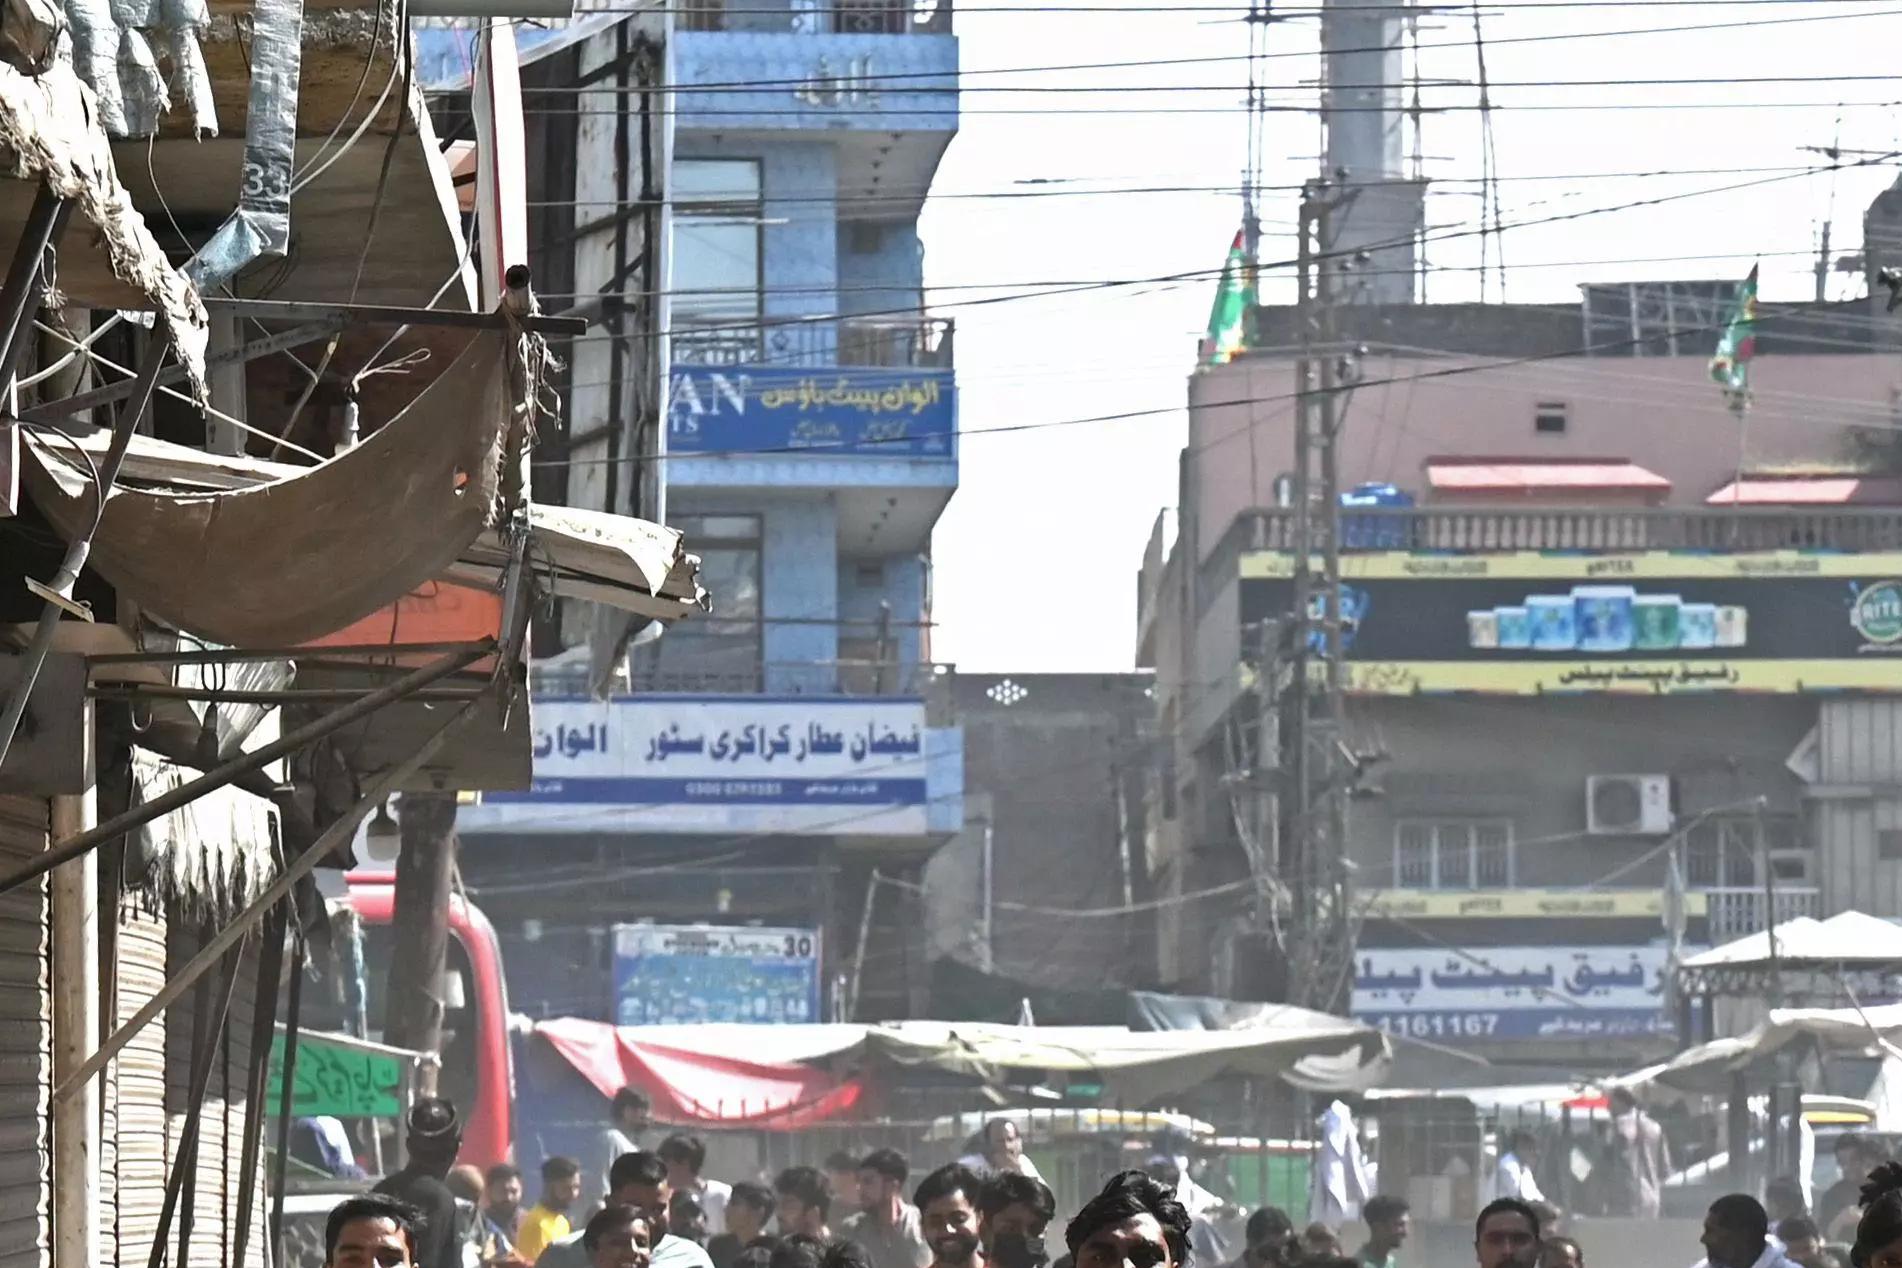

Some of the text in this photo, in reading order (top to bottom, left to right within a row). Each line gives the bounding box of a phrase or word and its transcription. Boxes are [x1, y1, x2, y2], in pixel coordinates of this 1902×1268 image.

[667, 373, 752, 416] AN
[709, 722, 790, 762] کراکری
[796, 721, 843, 762] عطار
[850, 721, 920, 762] فیضان
[1355, 957, 1422, 1004] پیل
